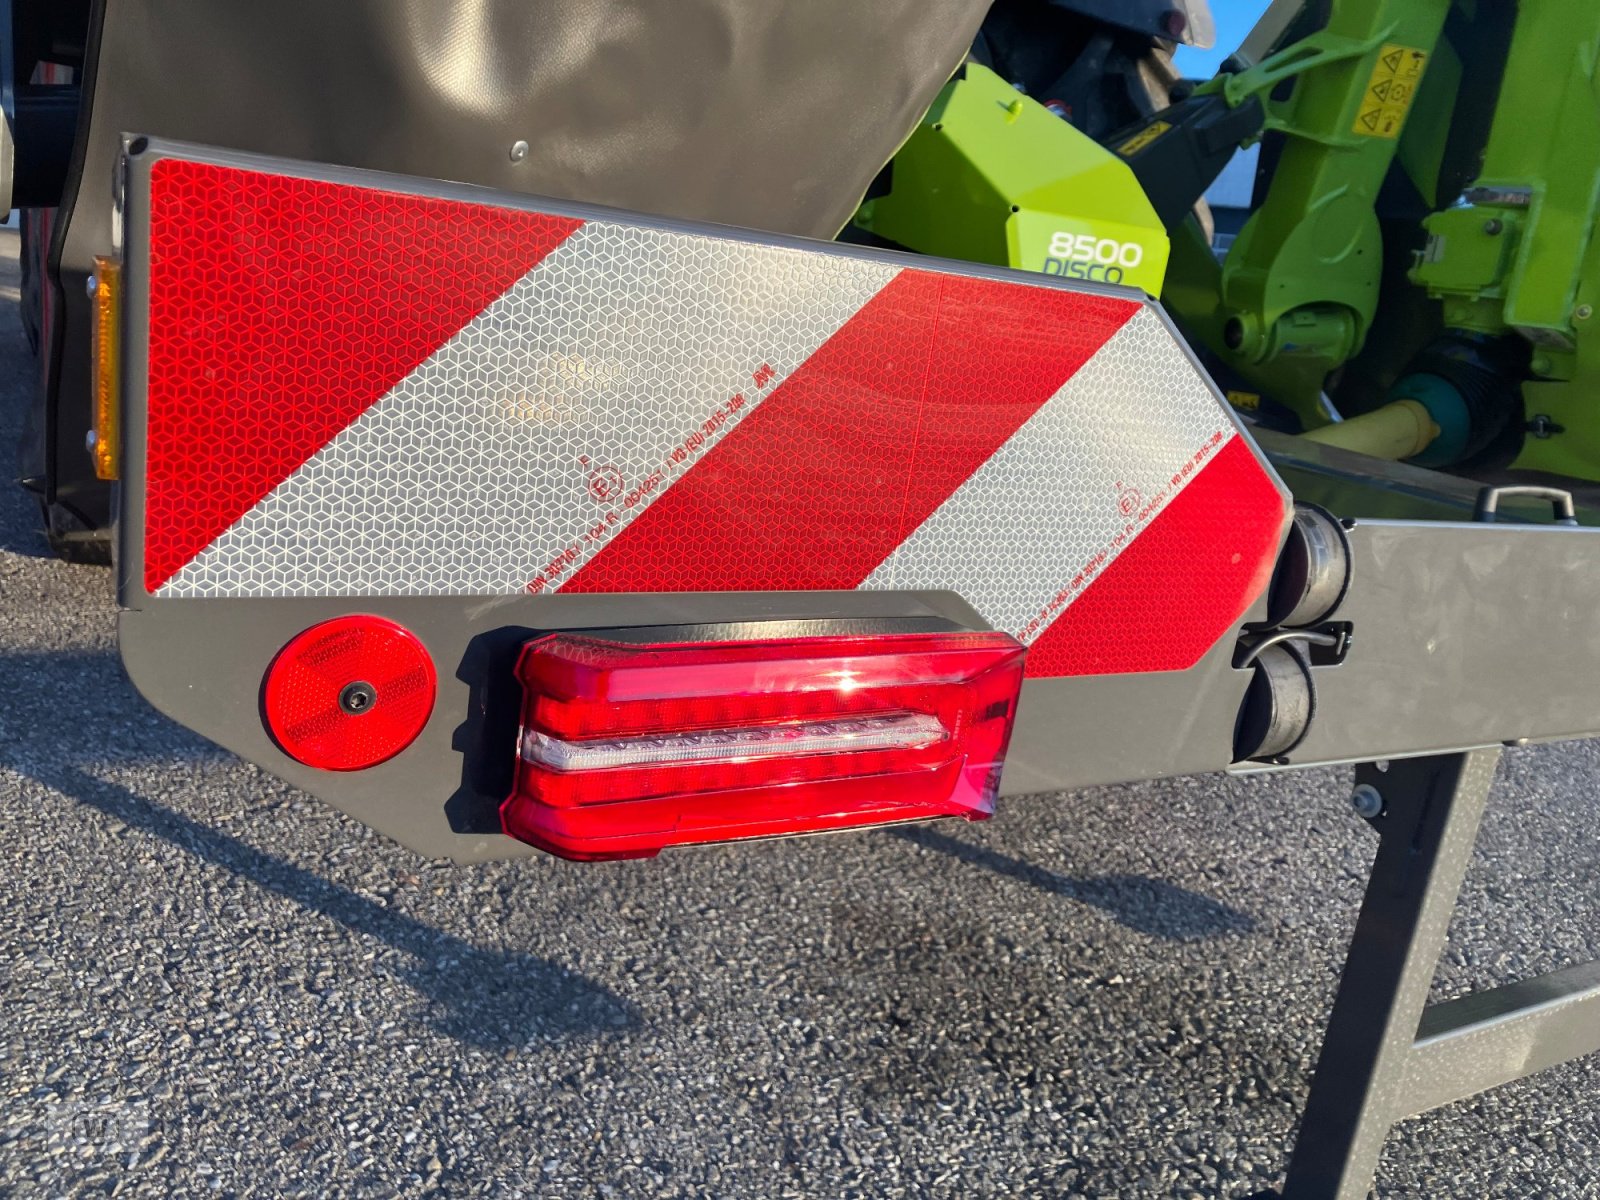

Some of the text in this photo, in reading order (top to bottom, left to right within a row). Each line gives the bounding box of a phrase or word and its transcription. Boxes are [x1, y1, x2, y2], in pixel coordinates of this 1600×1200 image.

[1048, 231, 1143, 268] 8500
[1043, 257, 1124, 284] DISCO
[526, 576, 548, 596] DIN
[584, 522, 608, 544] 104
[606, 512, 618, 525] R
[685, 431, 704, 454] (EU)
